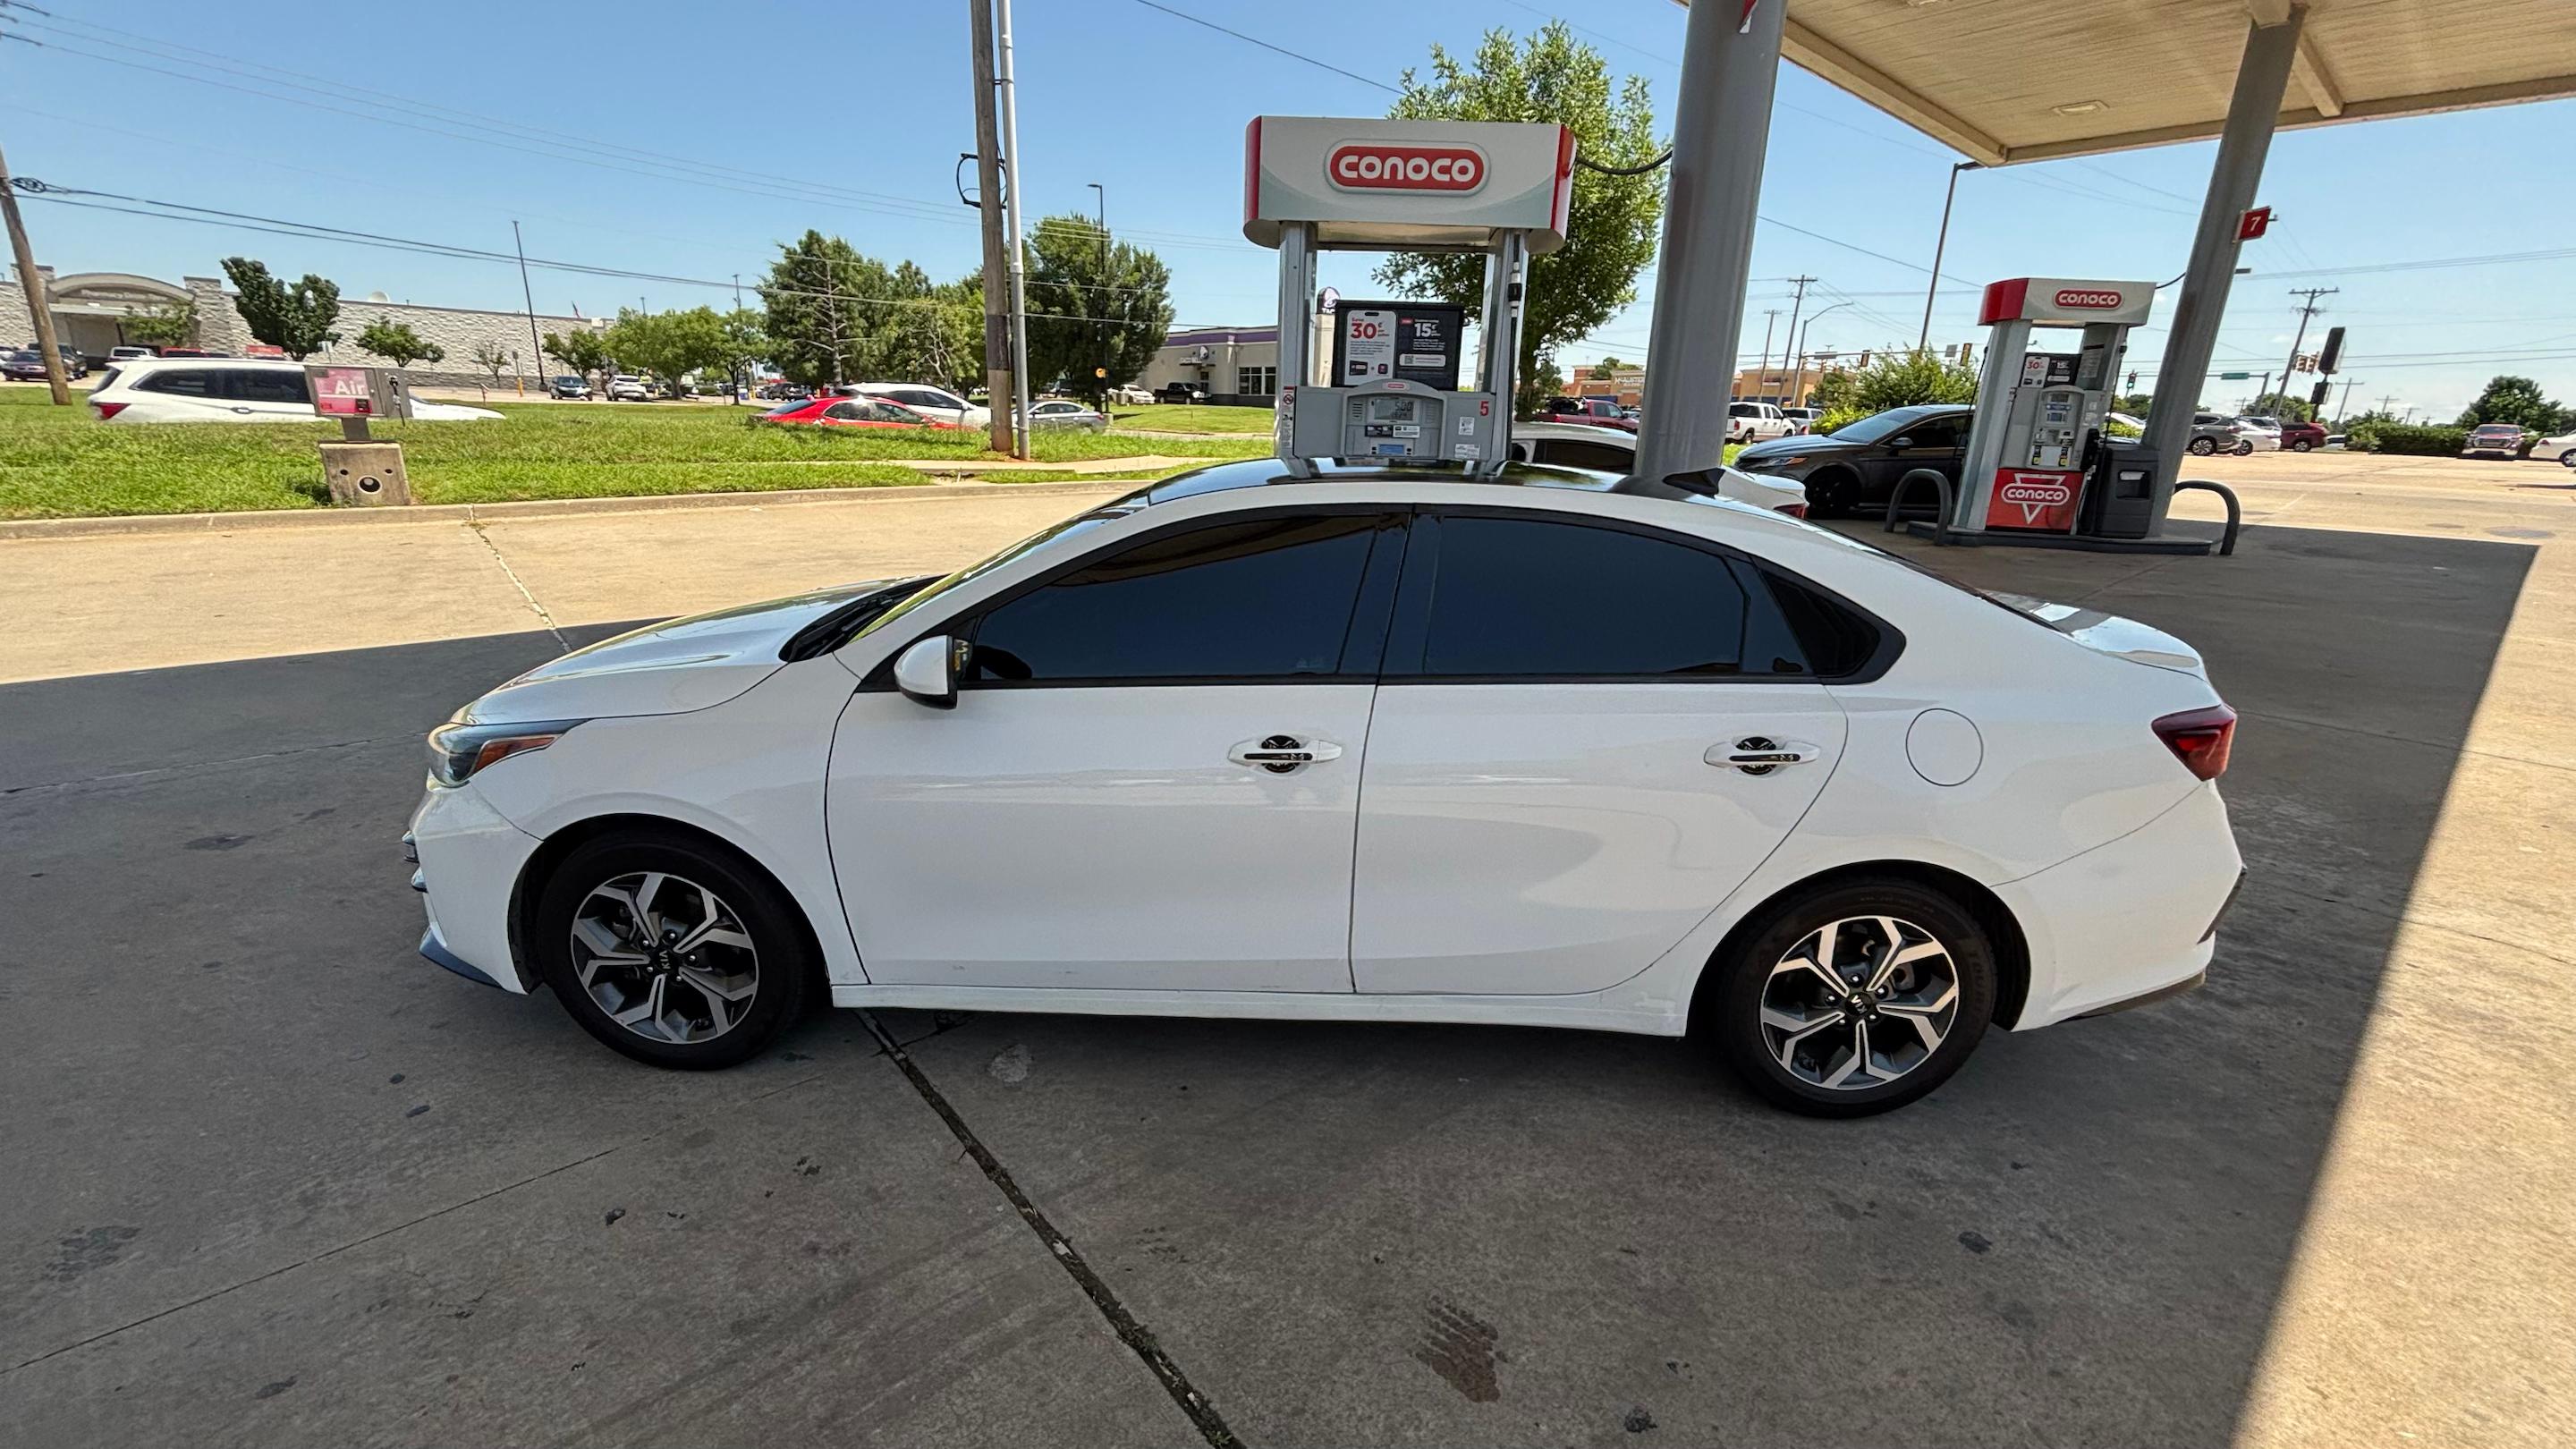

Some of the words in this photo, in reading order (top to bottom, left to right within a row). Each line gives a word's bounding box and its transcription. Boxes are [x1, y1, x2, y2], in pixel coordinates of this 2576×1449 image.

[2250, 216, 2262, 232] 7
[335, 380, 365, 394] Air
[1479, 401, 1489, 416] 5
[659, 950, 671, 969] KIA
